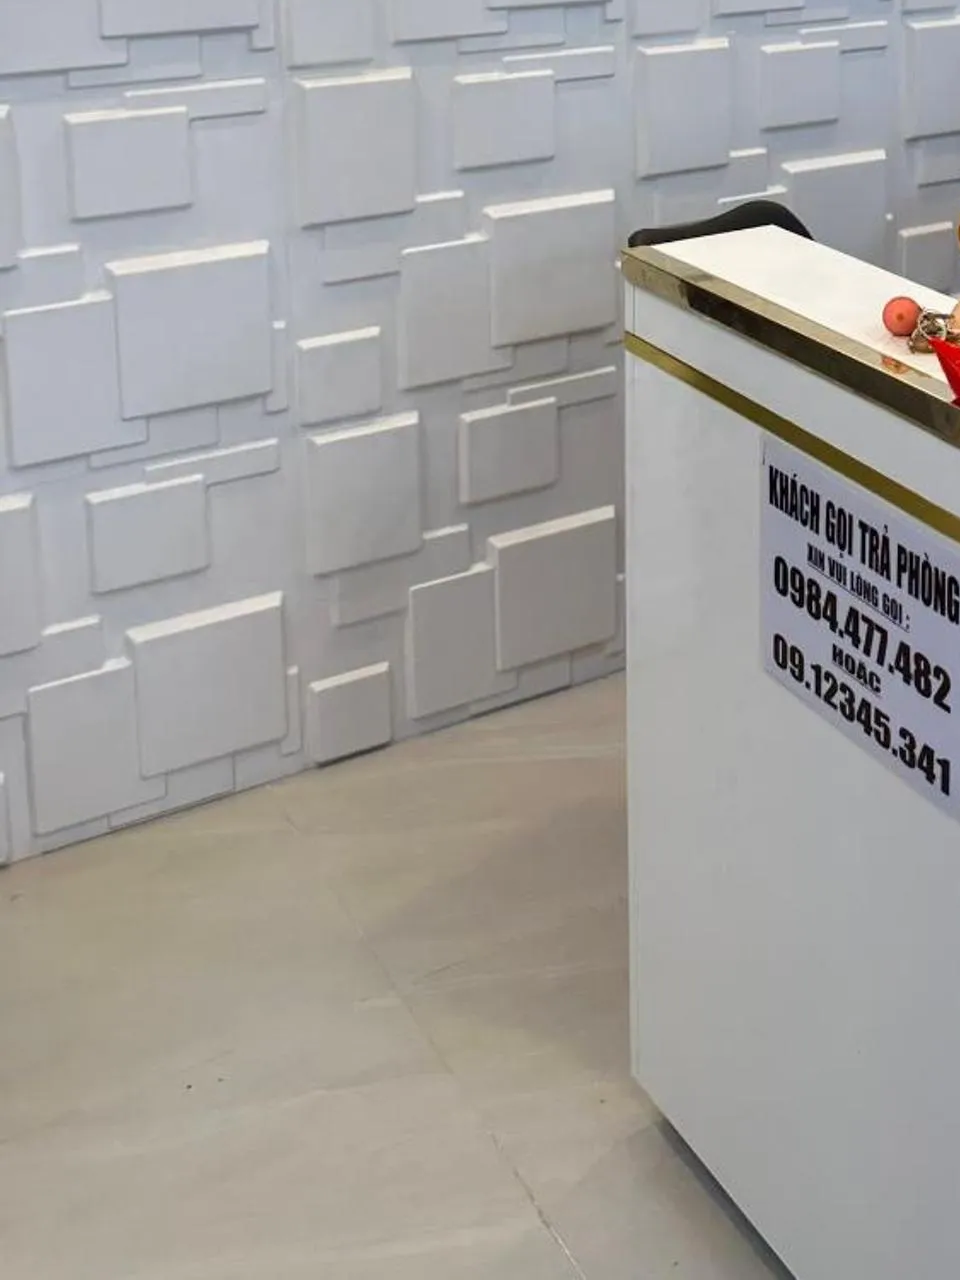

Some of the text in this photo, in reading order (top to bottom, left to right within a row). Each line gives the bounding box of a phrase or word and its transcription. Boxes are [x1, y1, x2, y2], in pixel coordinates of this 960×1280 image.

[769, 464, 960, 625] KHÁCH GỌI TRẢ PHÒNG
[807, 542, 825, 572] XIN
[828, 556, 848, 586] VUI
[774, 555, 951, 714] 0984.477.482
[773, 633, 951, 797] 09.12345.341
